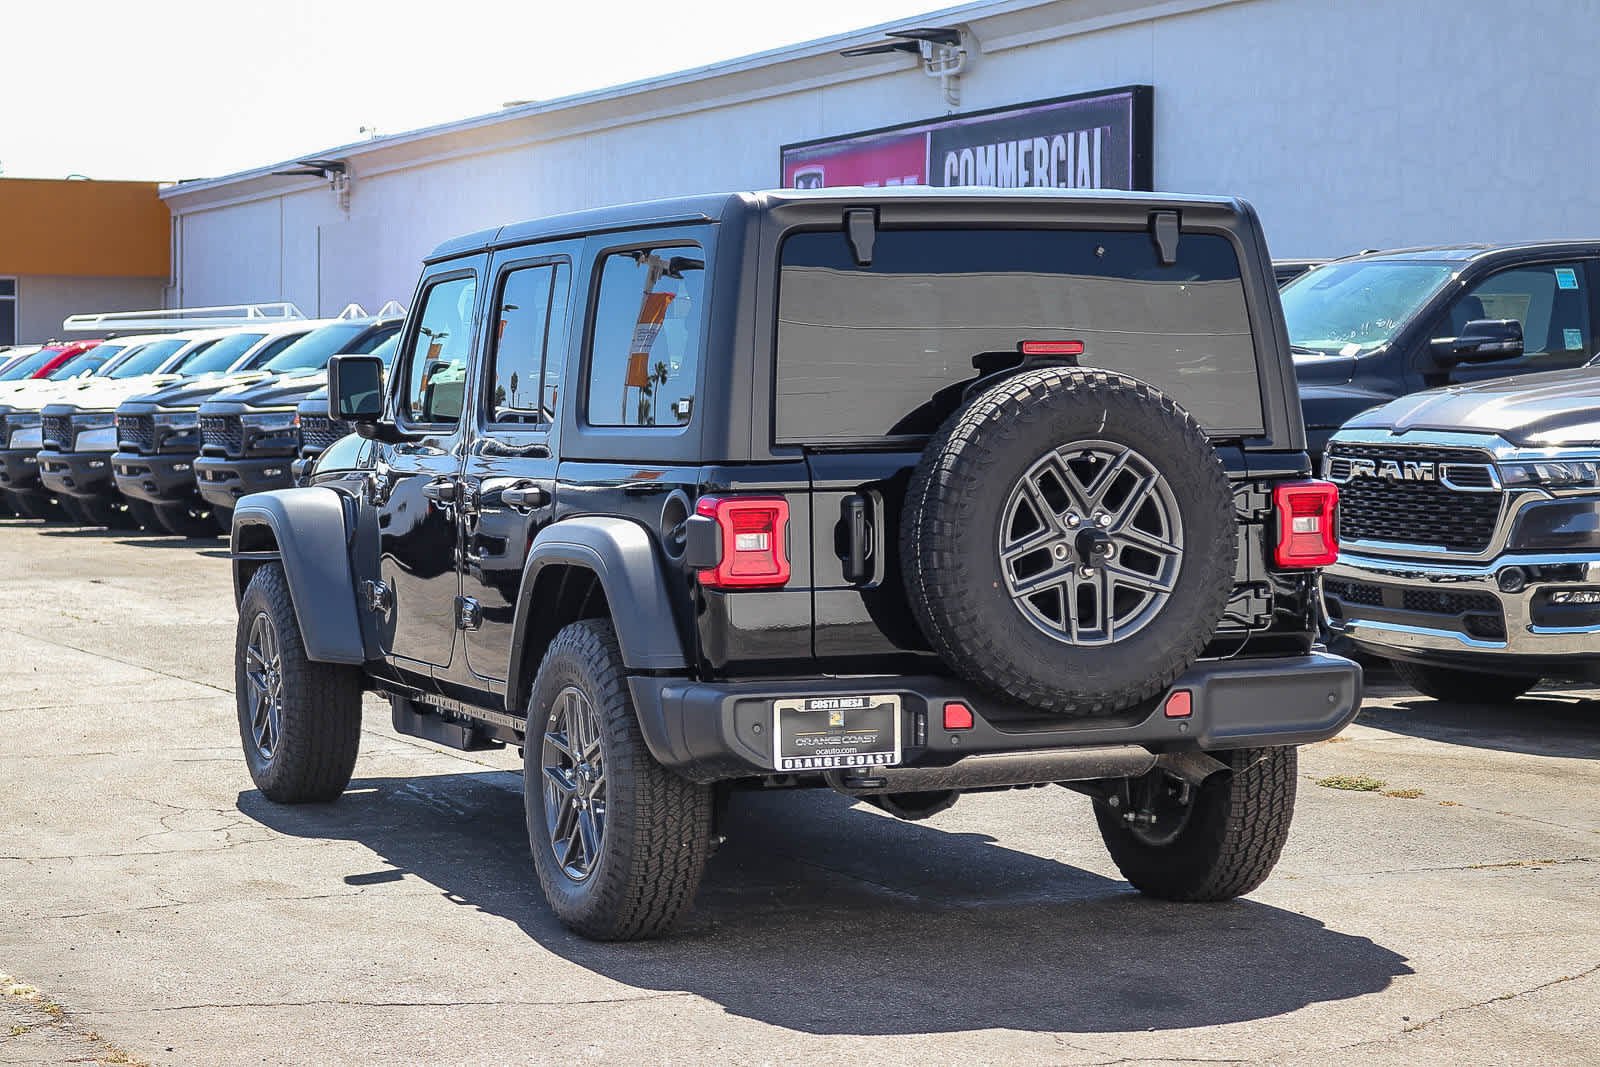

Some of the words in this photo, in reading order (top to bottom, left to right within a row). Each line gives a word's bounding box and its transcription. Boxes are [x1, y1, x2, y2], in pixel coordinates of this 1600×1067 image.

[944, 128, 1102, 188] COMMERCIAL
[1351, 459, 1435, 481] RAM
[810, 700, 838, 709] COSTA
[840, 698, 864, 707] MESA
[795, 736, 840, 746] ORANGE
[841, 734, 878, 744] COAST
[784, 757, 841, 769] ORANGE
[846, 753, 893, 765] COAST
